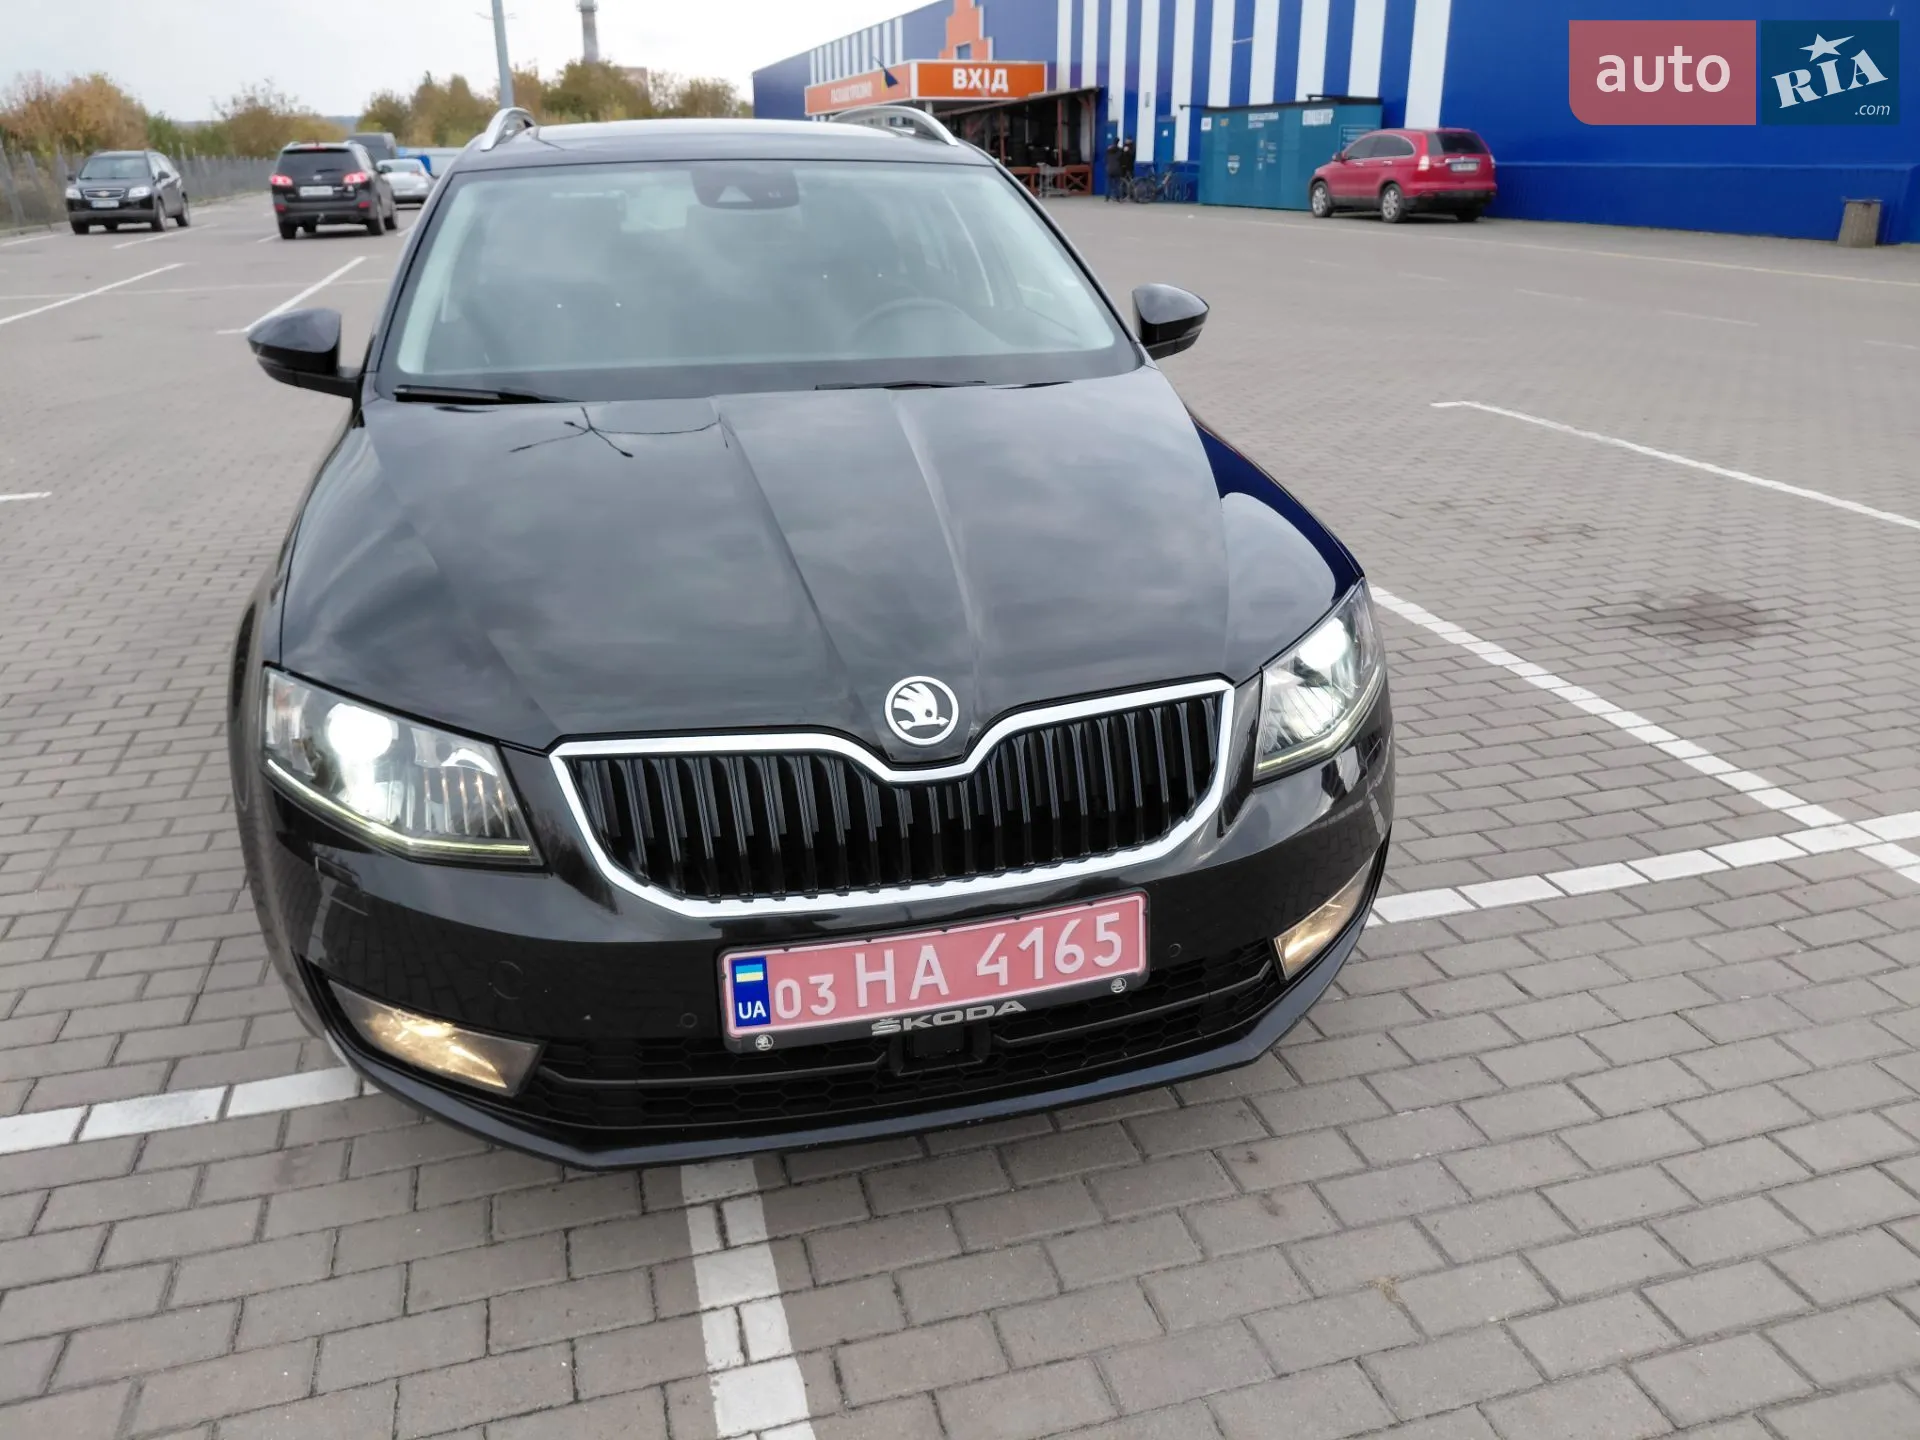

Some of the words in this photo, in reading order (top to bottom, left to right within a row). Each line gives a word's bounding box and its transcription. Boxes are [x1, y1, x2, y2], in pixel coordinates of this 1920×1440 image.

[953, 68, 1009, 93] ВХІД
[774, 975, 837, 1019] 03
[855, 944, 950, 1008] HA
[976, 912, 1123, 986] 4165
[738, 1001, 767, 1020] UA
[871, 1000, 1026, 1036] ŠKODA
